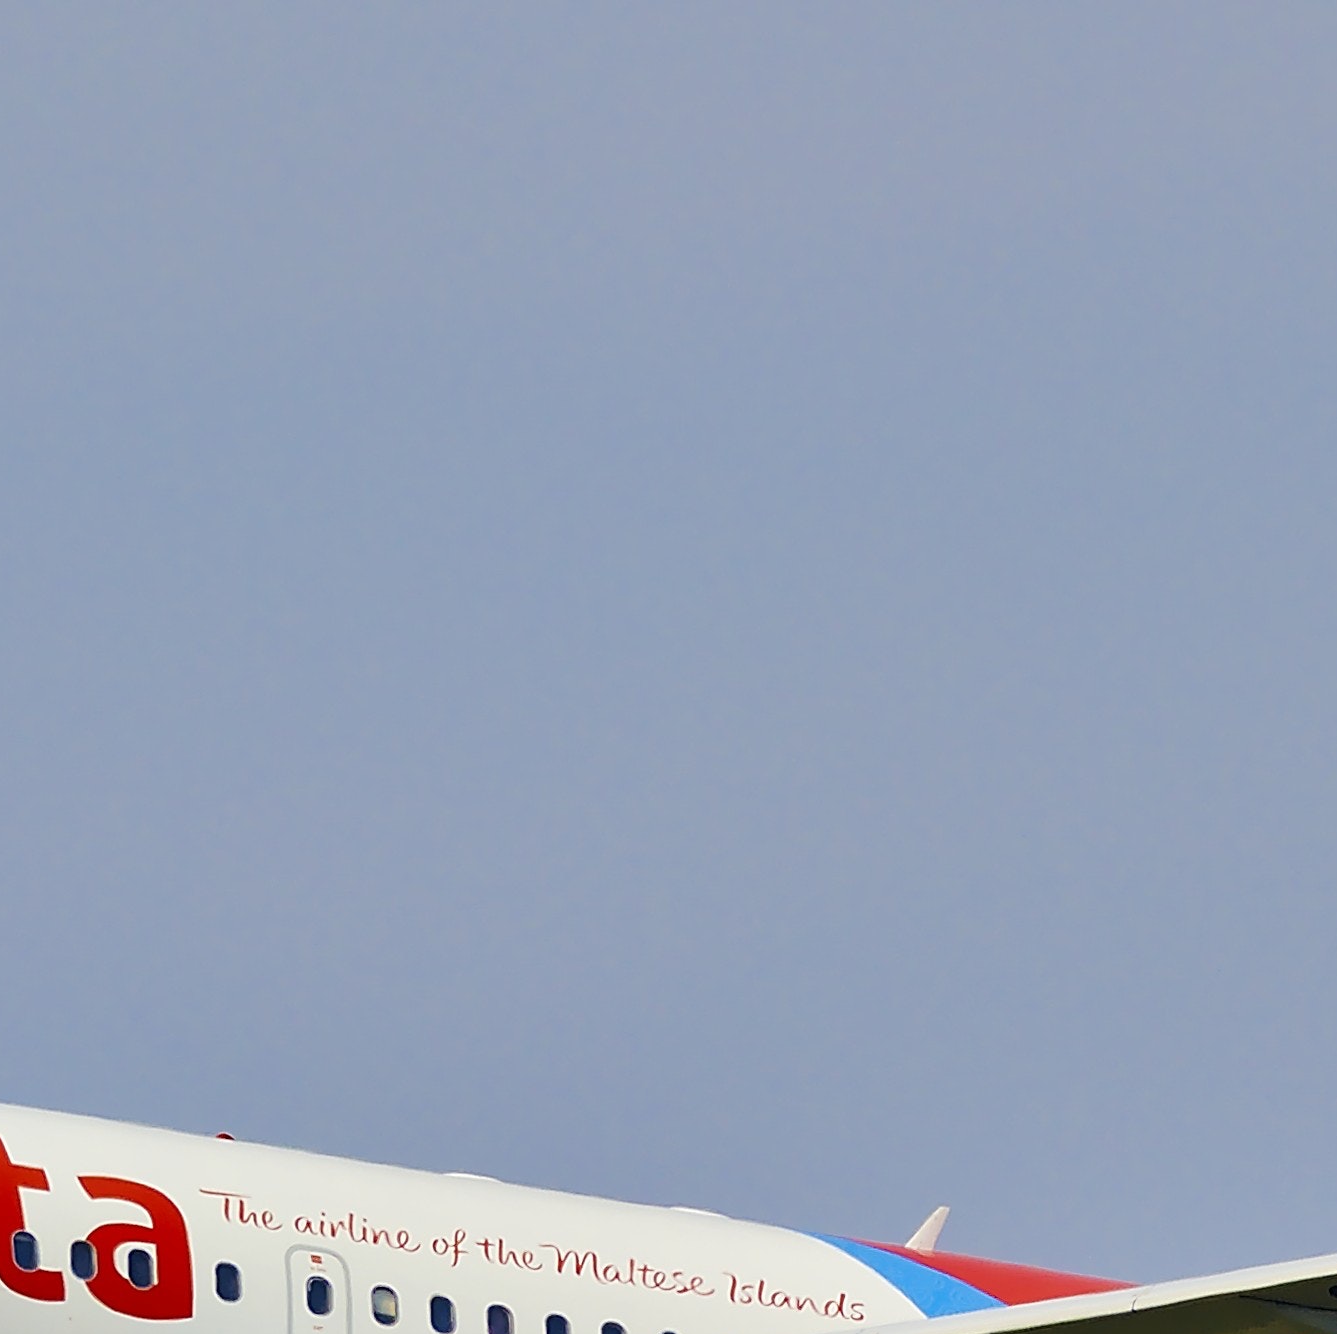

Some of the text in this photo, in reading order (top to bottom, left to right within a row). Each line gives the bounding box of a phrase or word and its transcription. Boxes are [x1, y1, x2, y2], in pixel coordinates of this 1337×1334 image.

[199, 1188, 865, 1322] The airline of the Maltese Islands
